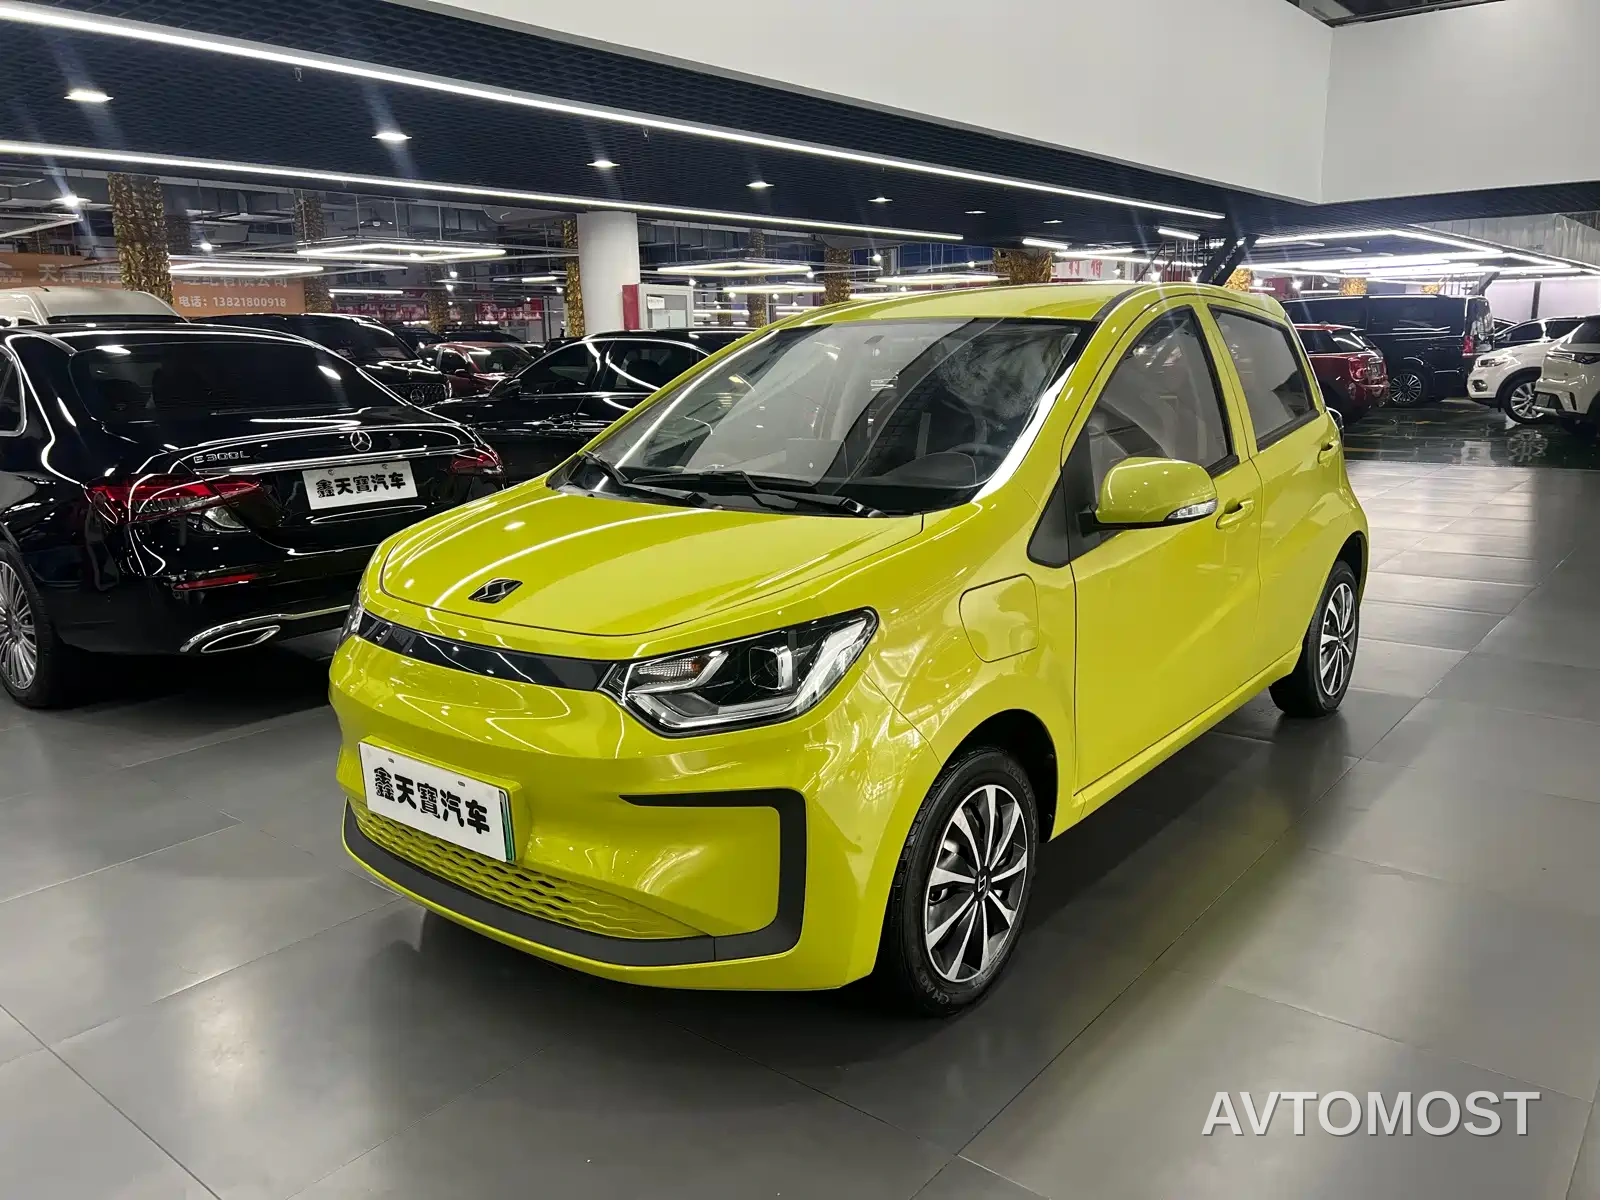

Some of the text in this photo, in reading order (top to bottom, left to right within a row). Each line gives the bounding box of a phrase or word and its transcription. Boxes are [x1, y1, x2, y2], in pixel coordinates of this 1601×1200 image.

[213, 297, 287, 307] 13821800918
[315, 472, 407, 498] 鑫天寶汽车
[373, 766, 490, 835] 鑫天寶汽车
